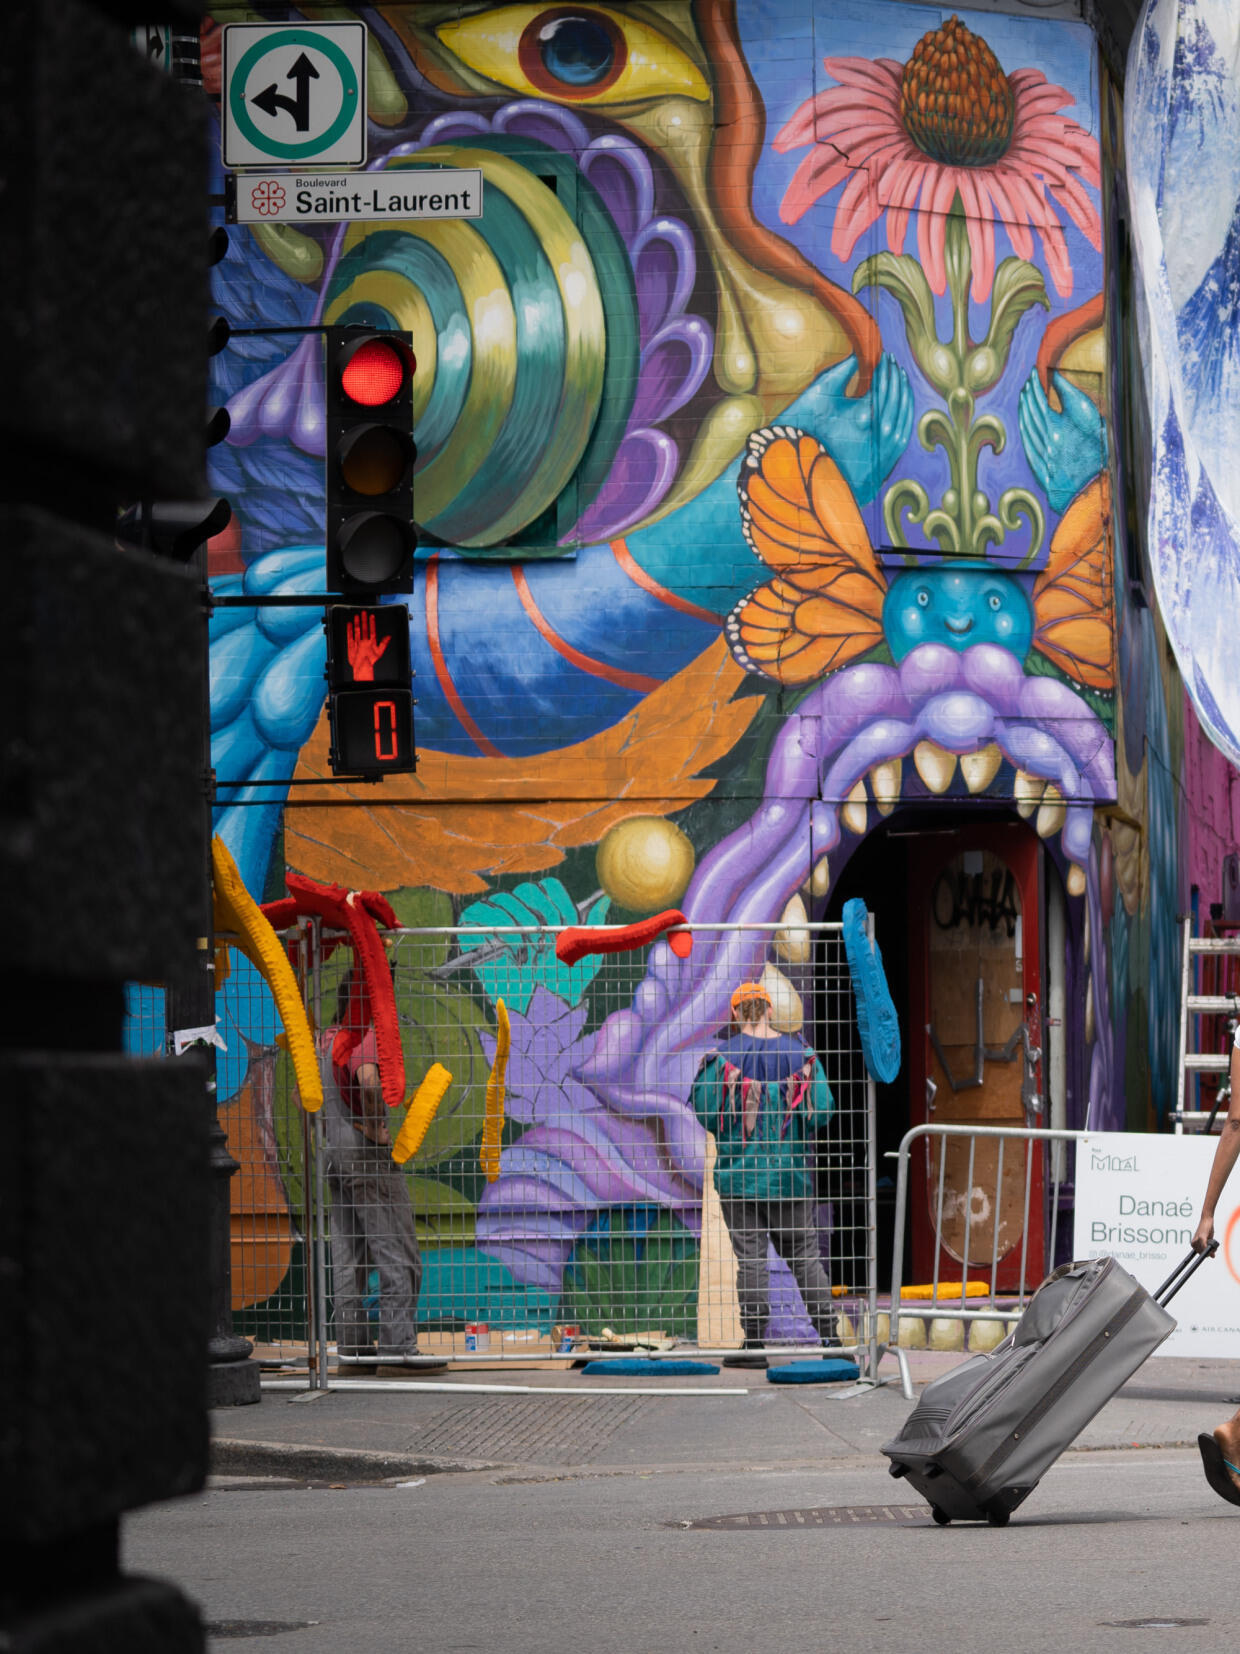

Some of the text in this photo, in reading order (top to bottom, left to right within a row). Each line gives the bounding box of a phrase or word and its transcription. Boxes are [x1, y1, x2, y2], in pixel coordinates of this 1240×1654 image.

[295, 178, 347, 188] Boulevard
[295, 189, 471, 214] Saint-Laurent
[373, 700, 399, 760] 0
[1118, 1195, 1193, 1218] Danaé
